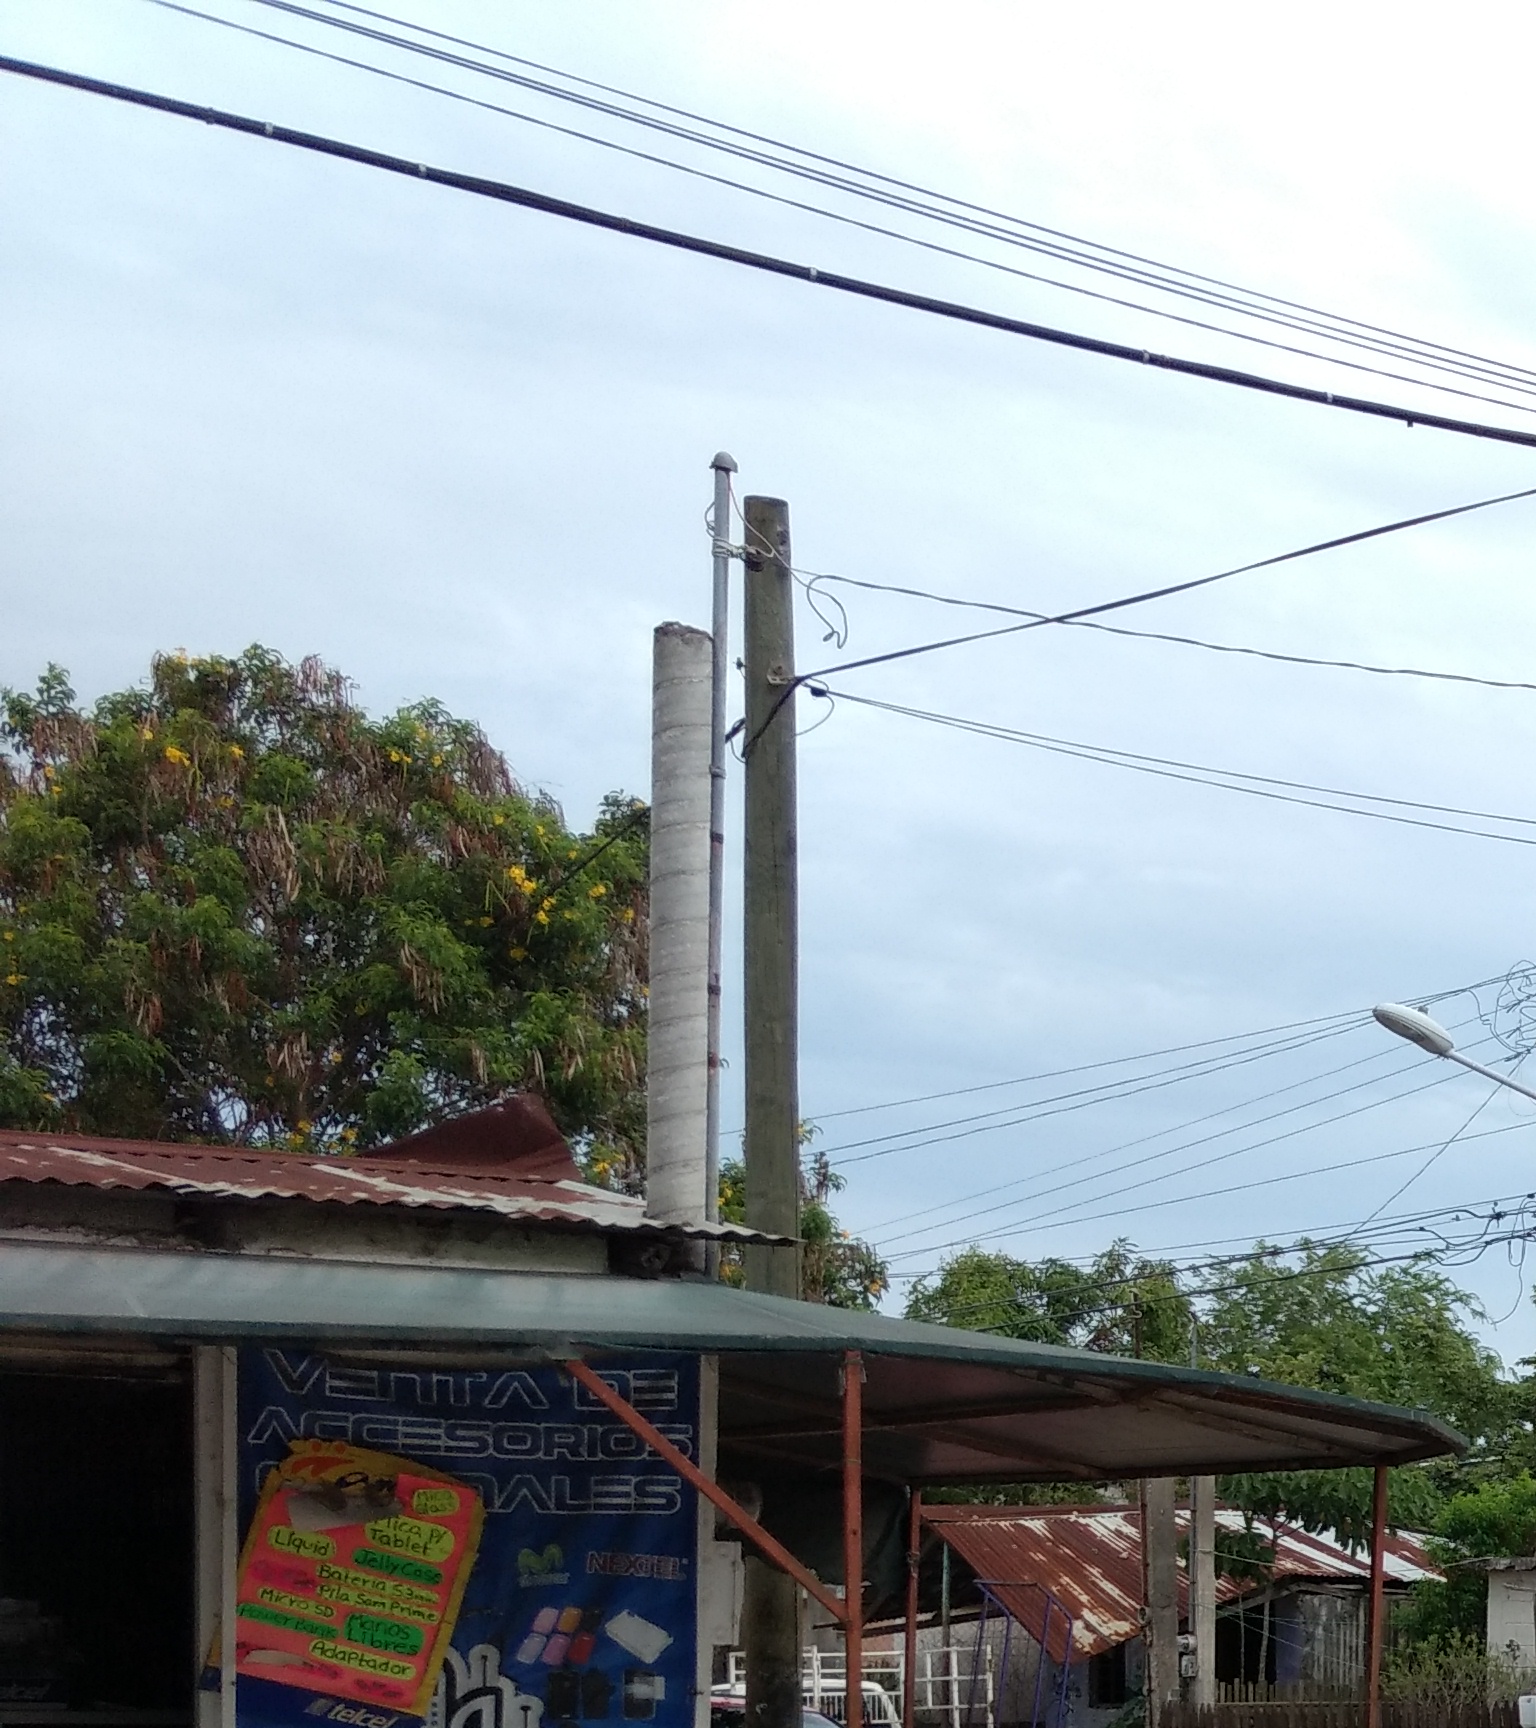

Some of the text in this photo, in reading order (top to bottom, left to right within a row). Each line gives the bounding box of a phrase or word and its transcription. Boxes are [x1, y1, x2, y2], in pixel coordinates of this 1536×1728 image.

[265, 1349, 678, 1411] VENTA DE
[247, 1406, 693, 1461] ACCESORIOS
[370, 1528, 432, 1557] Tablet
[587, 1551, 682, 1580] NEXTEL
[315, 1604, 336, 1619] SD
